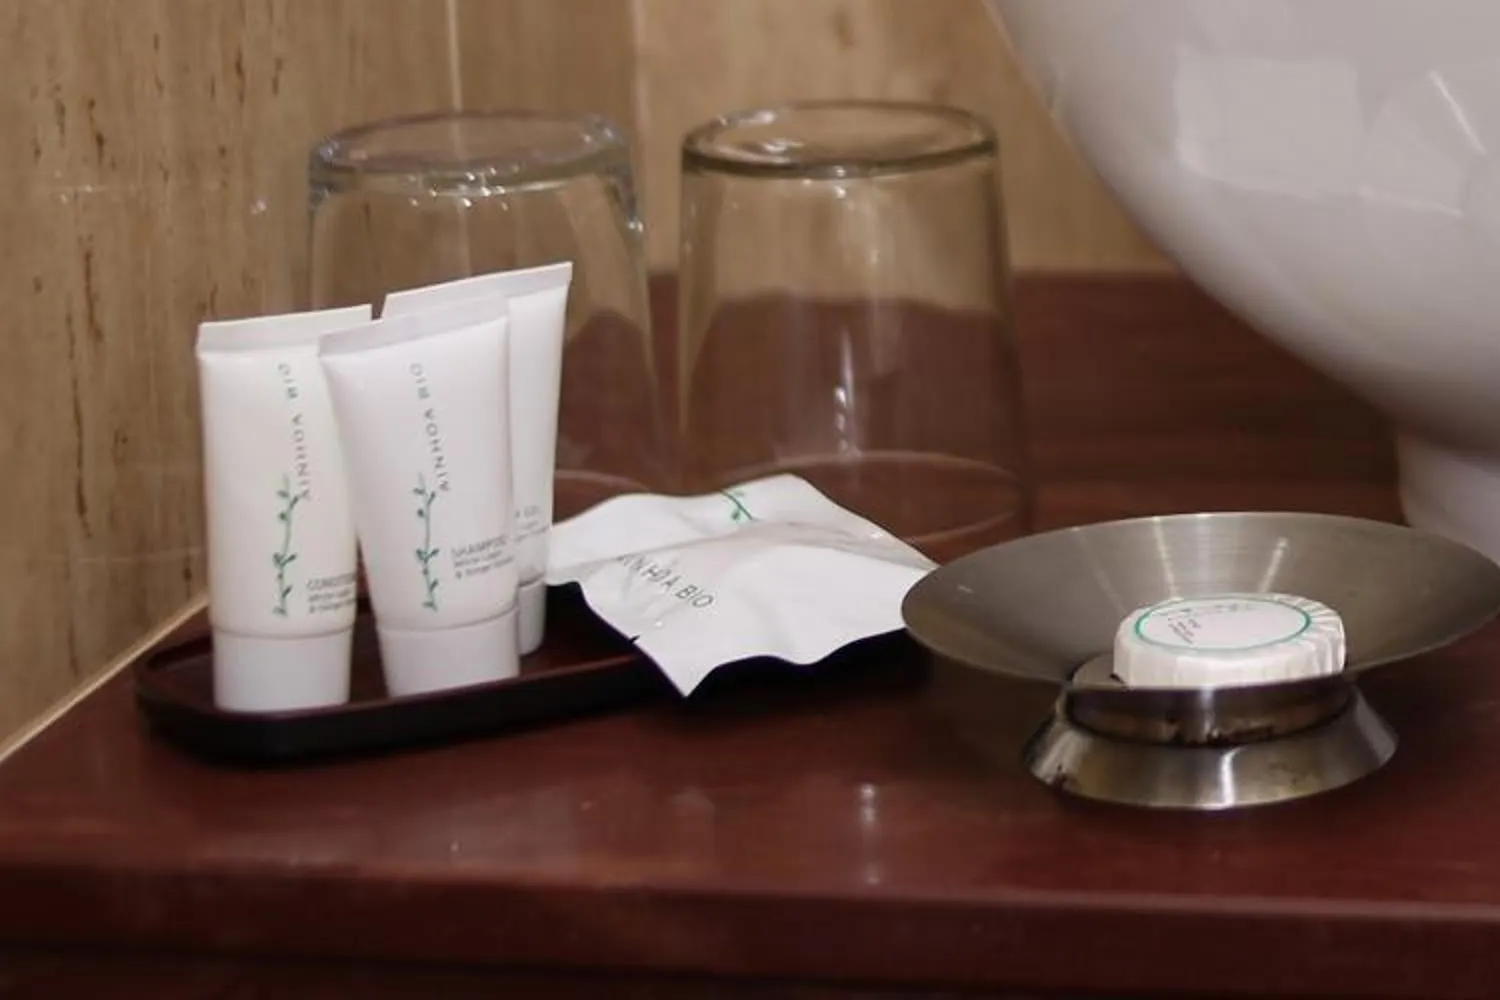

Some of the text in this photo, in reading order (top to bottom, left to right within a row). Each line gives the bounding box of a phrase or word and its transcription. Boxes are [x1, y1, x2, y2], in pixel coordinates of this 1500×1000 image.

[409, 362, 451, 492] AINHOA BIO
[674, 583, 714, 608] BIO
